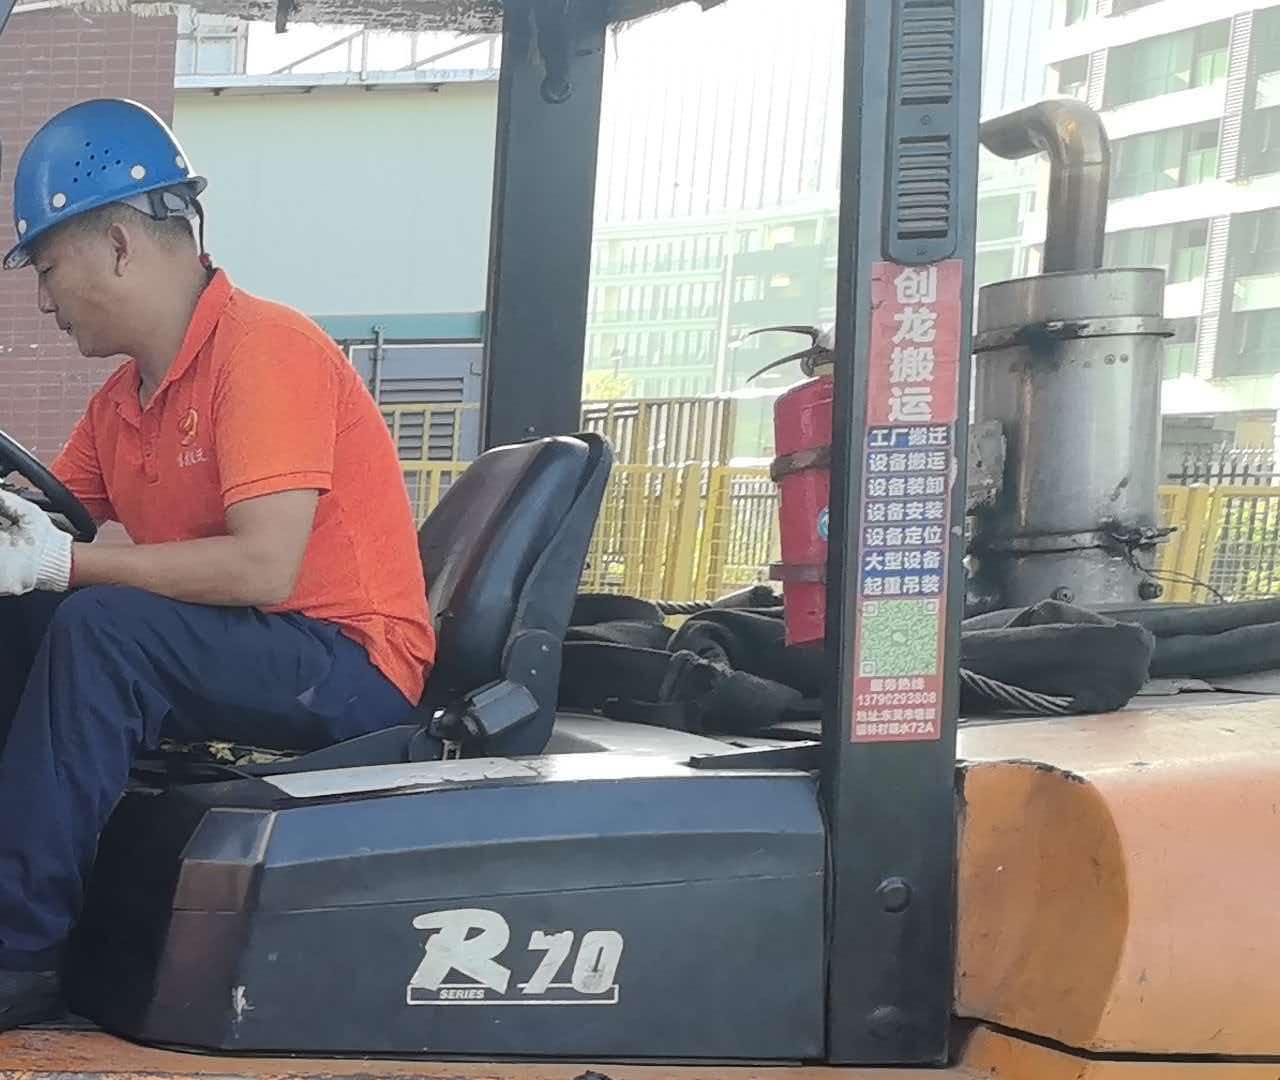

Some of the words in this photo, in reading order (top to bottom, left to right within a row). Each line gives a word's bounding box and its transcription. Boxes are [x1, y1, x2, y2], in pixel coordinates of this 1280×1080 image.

[888, 265, 938, 422] 创龙搬运
[870, 427, 947, 446] 工厂搬迁
[869, 452, 946, 472] 设备搬运
[868, 477, 944, 496] 设备装卸
[867, 502, 944, 521] 设备安装
[865, 527, 943, 546] 设备定位
[864, 551, 941, 570] 大型设备
[863, 576, 939, 595] 起重吊装
[410, 908, 511, 994] R
[522, 930, 624, 993] 70
[440, 989, 485, 999] SERIES
